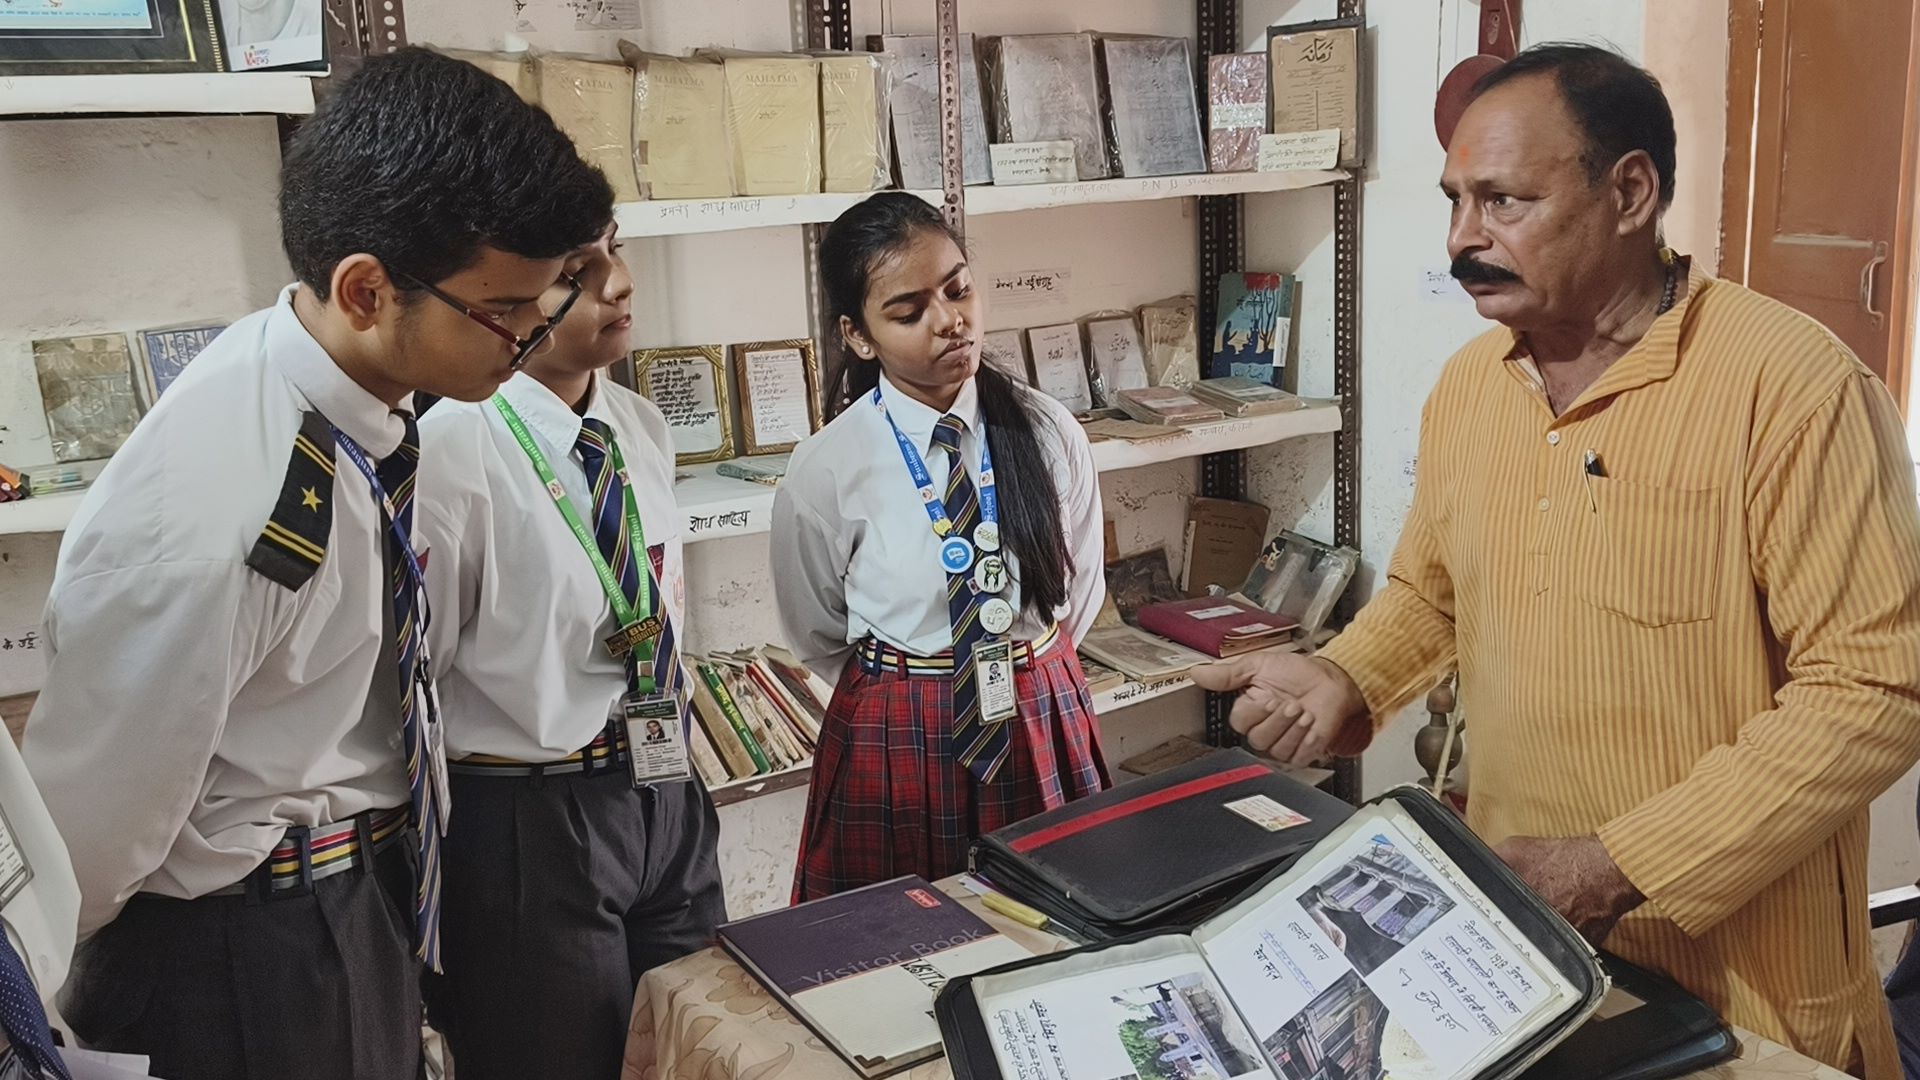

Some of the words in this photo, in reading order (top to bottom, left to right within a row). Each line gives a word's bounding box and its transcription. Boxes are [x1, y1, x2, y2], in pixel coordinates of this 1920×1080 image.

[745, 73, 798, 83] MAHATMA
[512, 420, 547, 473] Sunbeam
[903, 442, 926, 483] Sunbeam
[574, 523, 602, 562] School
[629, 514, 643, 551] School
[593, 563, 630, 616] Sunbeam
[629, 619, 657, 637] BUS
[630, 623, 663, 645] MONITOR
[801, 949, 903, 986] Visitor
[910, 925, 984, 959] Book
[1489, 951, 1509, 972] 1918
